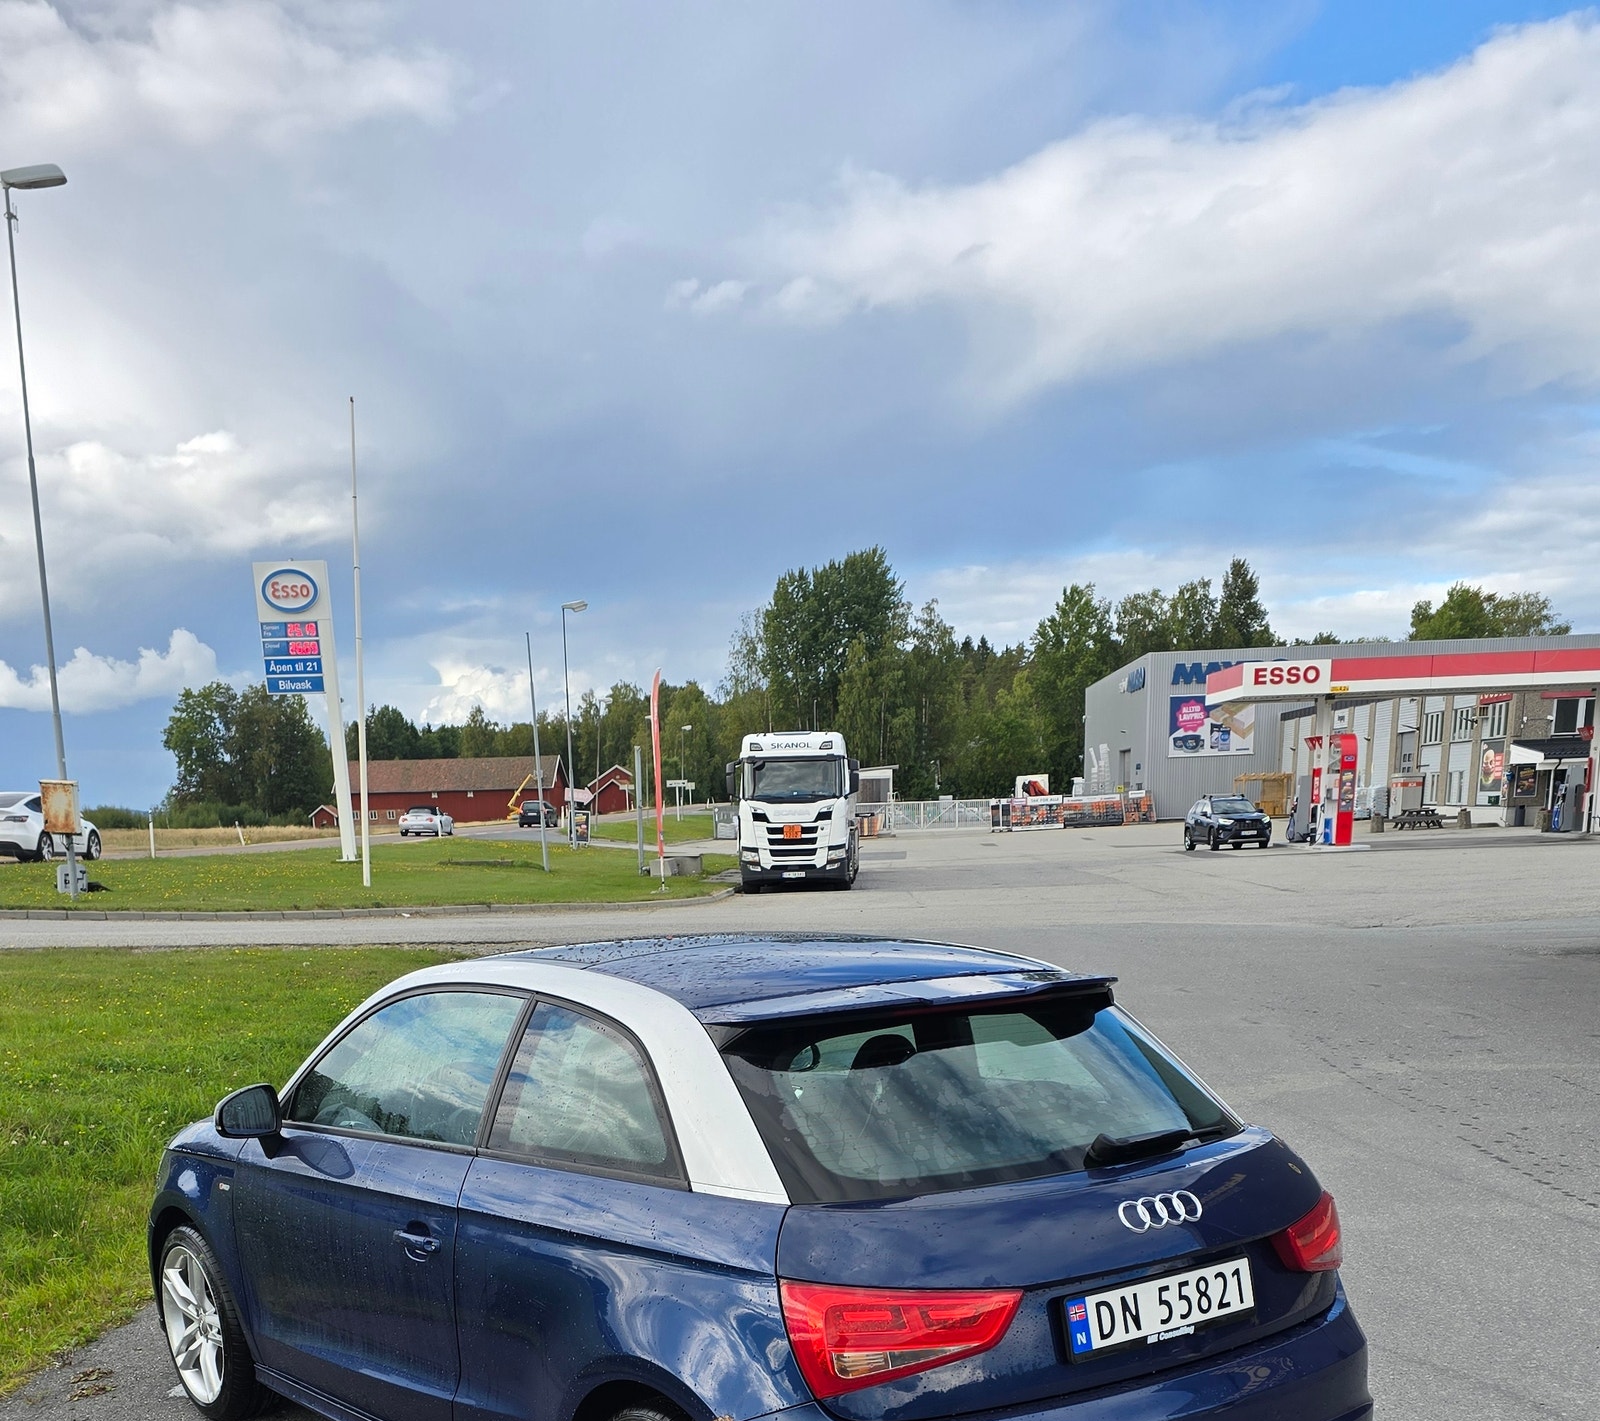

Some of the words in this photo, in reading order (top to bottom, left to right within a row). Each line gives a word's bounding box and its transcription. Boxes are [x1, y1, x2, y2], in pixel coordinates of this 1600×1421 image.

[270, 660, 293, 674] Åpen
[294, 661, 304, 671] til
[306, 661, 318, 671] 21
[1253, 665, 1321, 686] ESSO
[278, 680, 312, 691] Bilvask
[1182, 705, 1201, 714] ALLTID
[1179, 712, 1205, 721] LAVPRIS
[770, 741, 812, 750] SKANOL
[1095, 1293, 1142, 1340] DN
[1158, 1268, 1245, 1325] 55821
[1077, 1332, 1087, 1346] N
